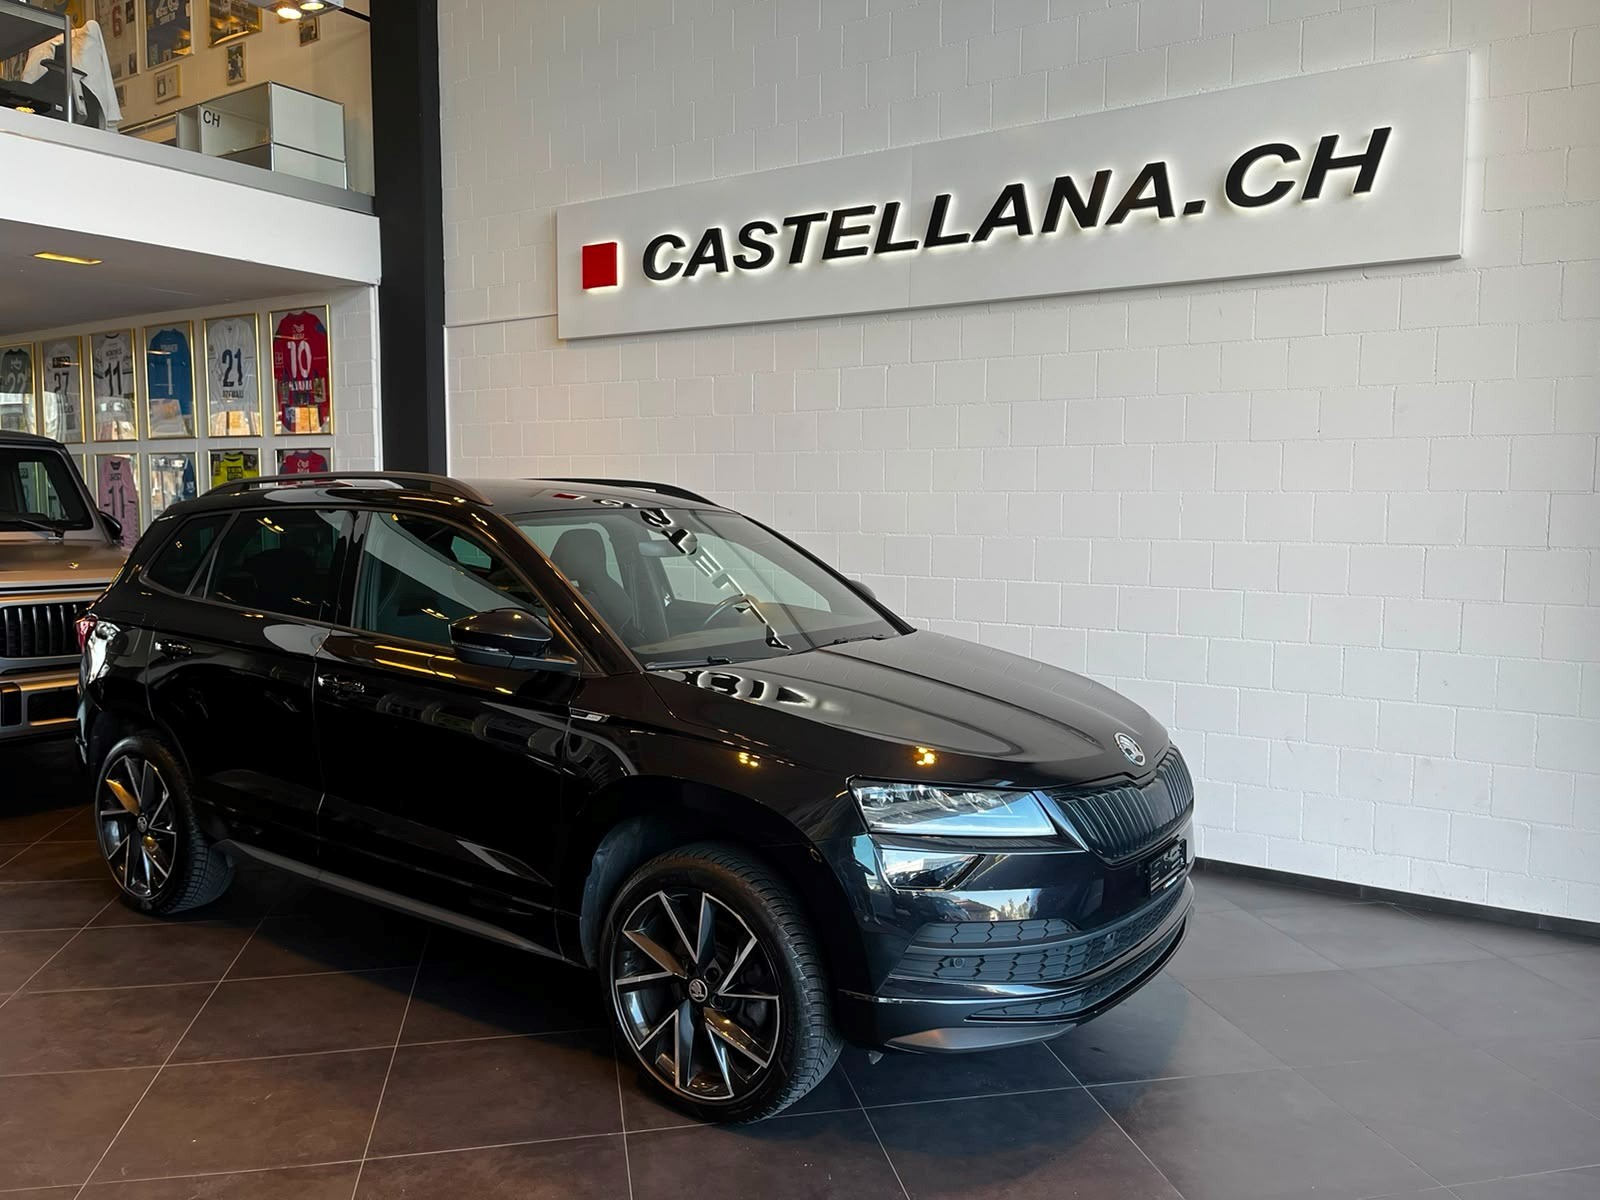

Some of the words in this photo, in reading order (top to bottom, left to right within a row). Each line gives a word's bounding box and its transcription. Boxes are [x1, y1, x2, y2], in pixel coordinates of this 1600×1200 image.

[203, 110, 220, 128] CH
[642, 127, 1392, 281] CASTELLANA.CH
[104, 360, 122, 397] 11
[222, 348, 243, 388] 21
[287, 340, 312, 379] 10
